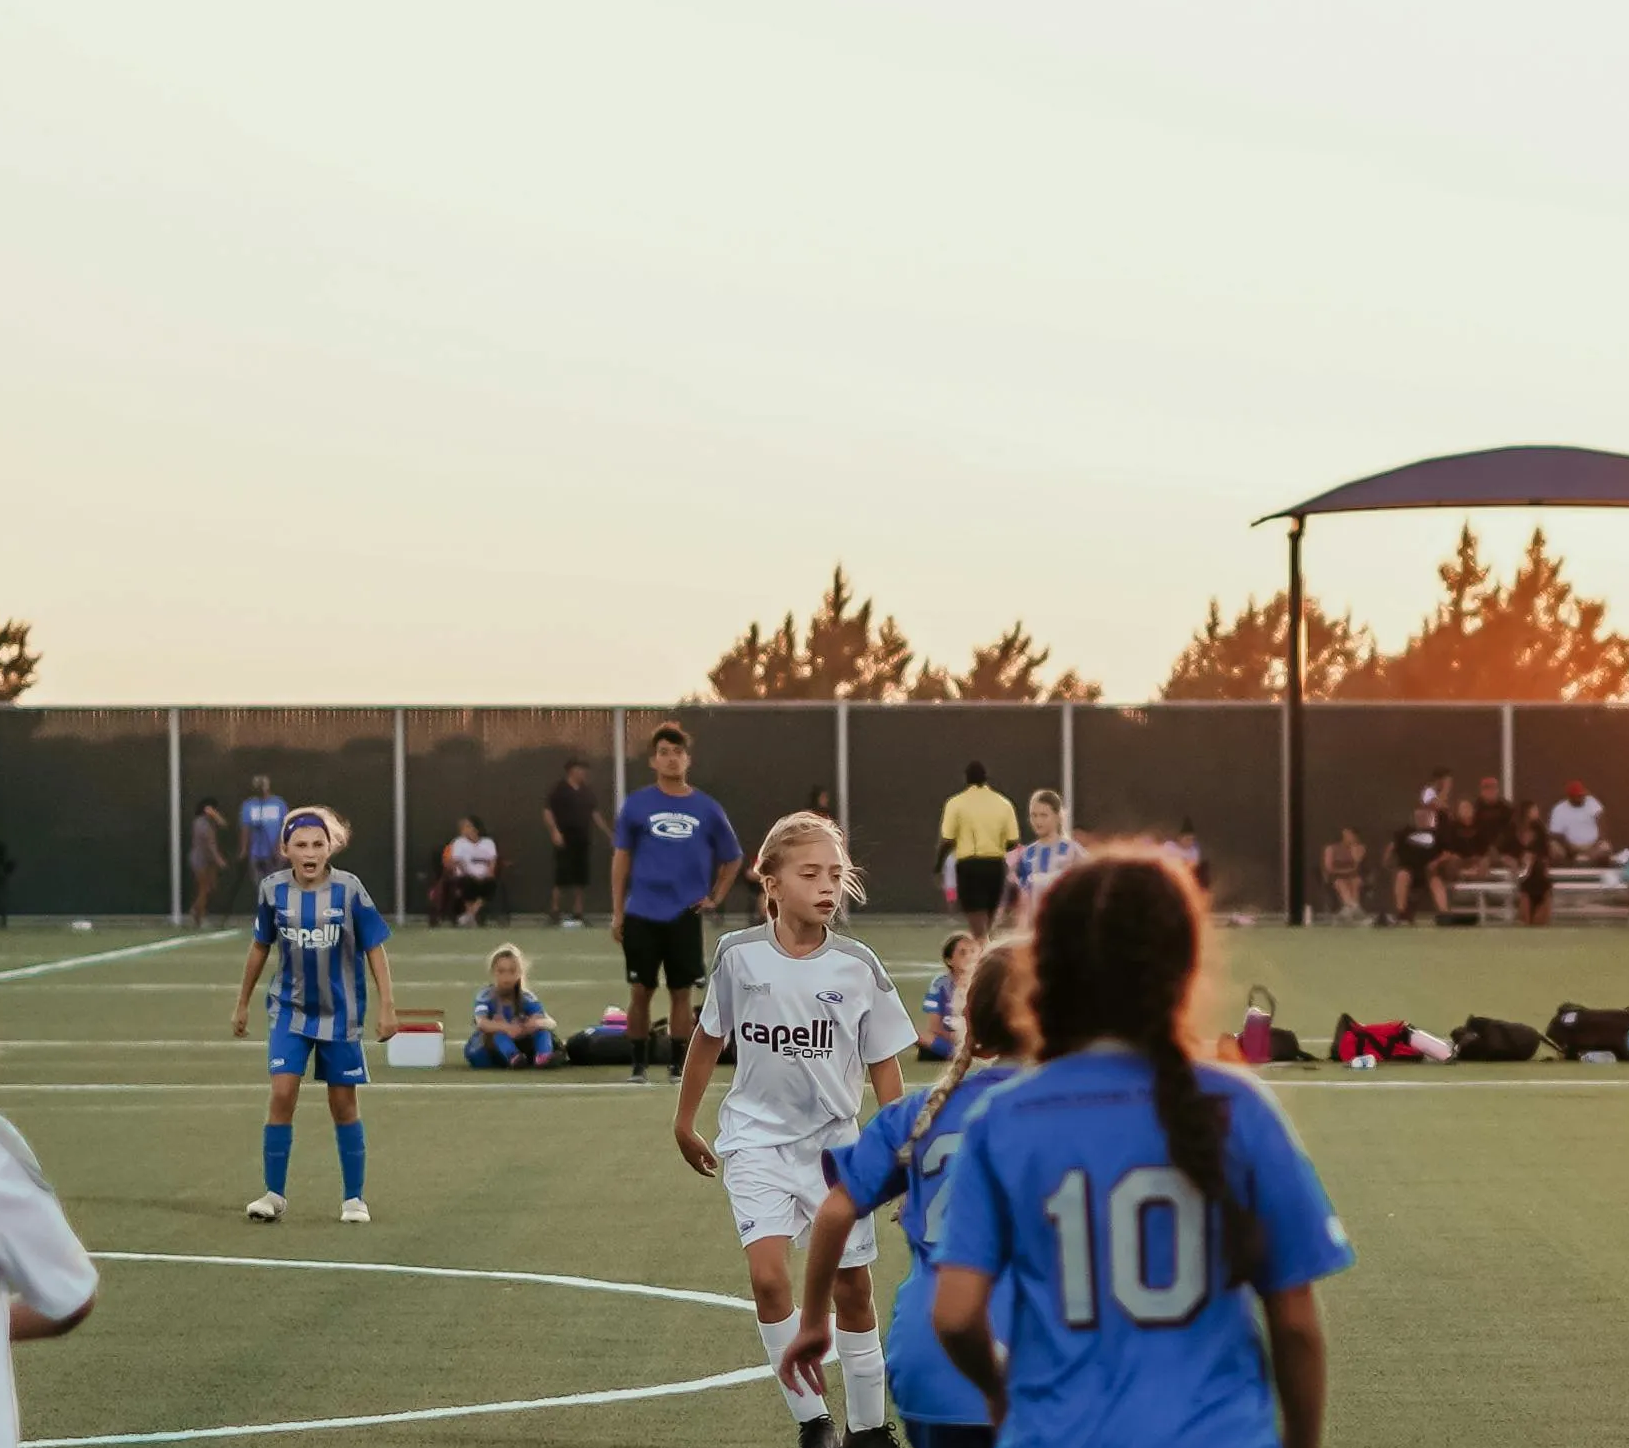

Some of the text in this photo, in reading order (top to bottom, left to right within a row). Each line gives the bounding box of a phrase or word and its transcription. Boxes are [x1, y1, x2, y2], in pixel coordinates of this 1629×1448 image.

[741, 1019, 833, 1052] capelli
[783, 1046, 833, 1059] SPORT
[1044, 1165, 1209, 1330] 10
